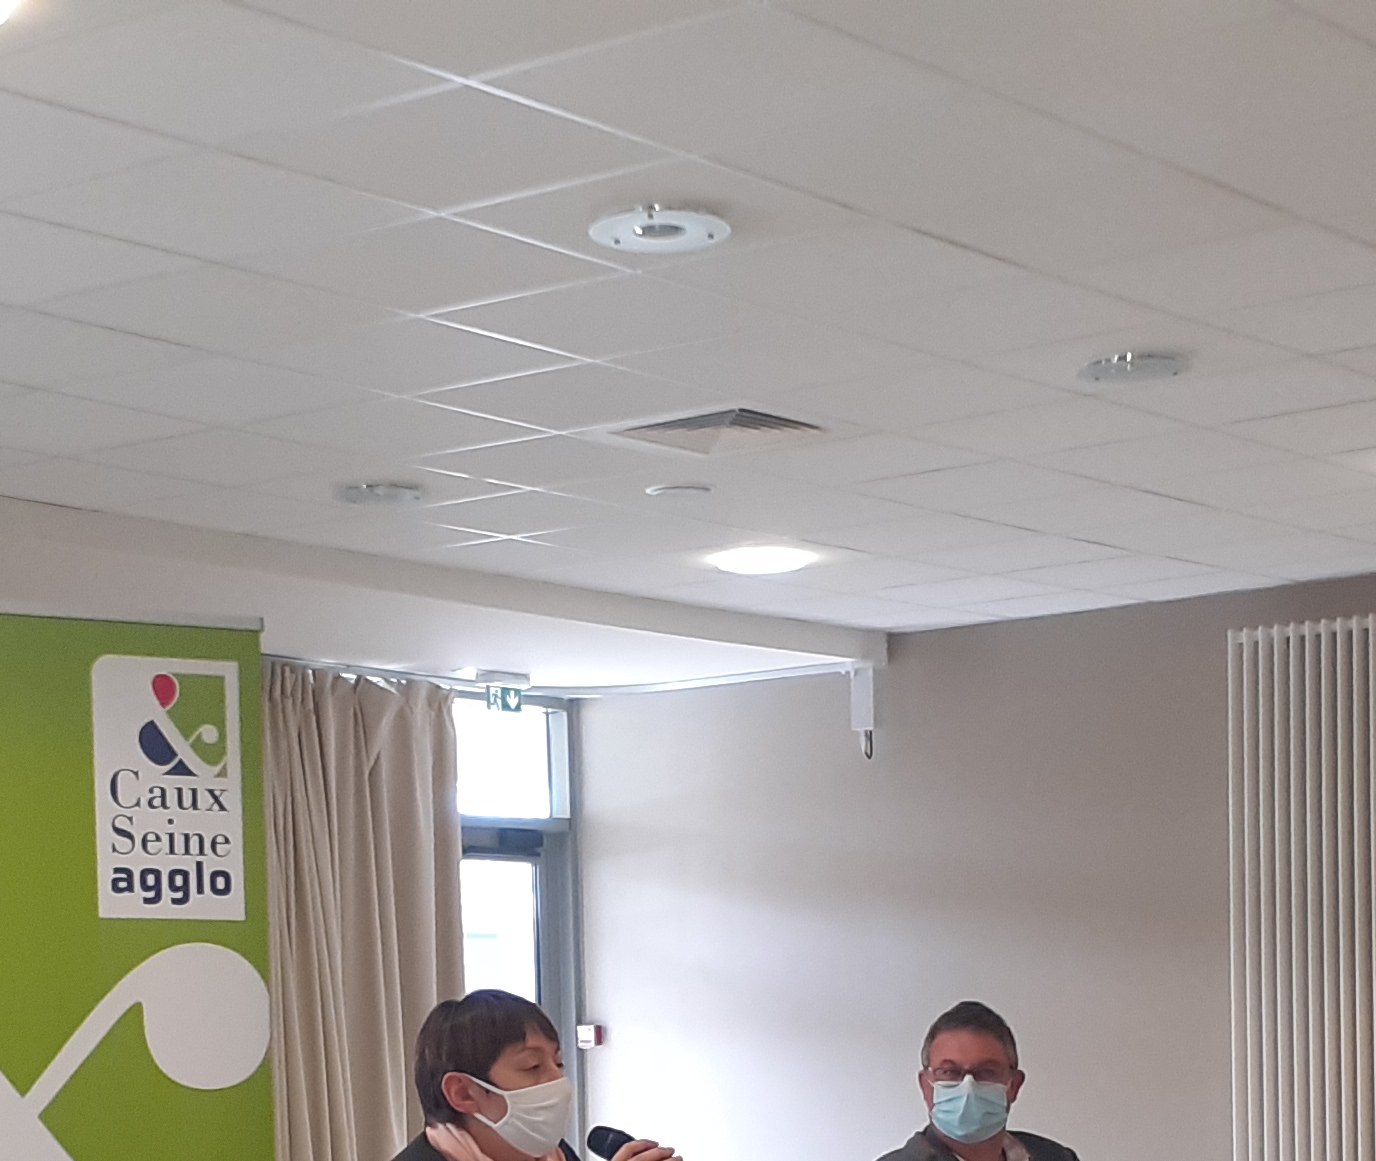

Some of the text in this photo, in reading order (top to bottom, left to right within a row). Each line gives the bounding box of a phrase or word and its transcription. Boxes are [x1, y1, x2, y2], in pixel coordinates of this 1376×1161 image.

[110, 768, 229, 812] Caux
[111, 814, 231, 858] Seine
[111, 860, 232, 905] agglo
